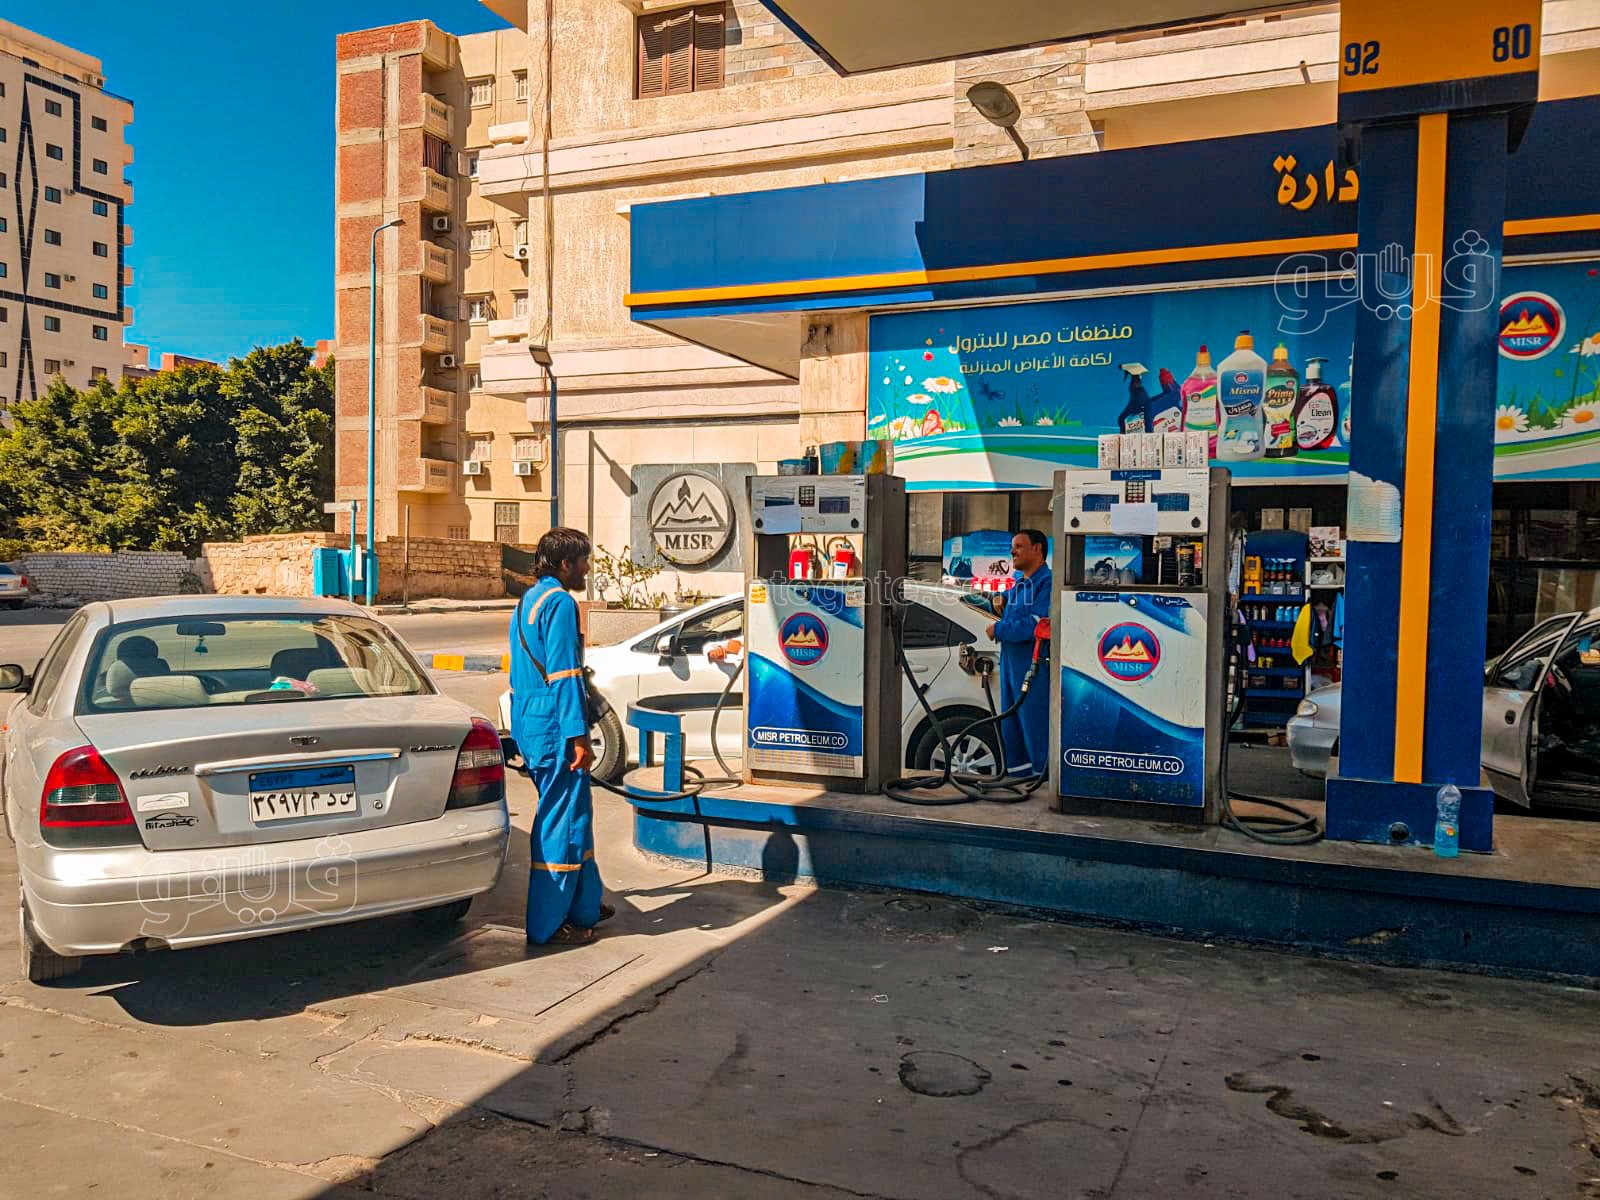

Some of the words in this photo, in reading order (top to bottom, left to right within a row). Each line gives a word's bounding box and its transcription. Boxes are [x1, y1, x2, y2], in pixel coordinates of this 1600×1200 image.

[1492, 23, 1532, 62] 80
[1344, 41, 1380, 76] 92
[1012, 332, 1051, 350] مصر
[1057, 325, 1133, 343] منظفات
[1510, 336, 1542, 347] MISR
[948, 331, 1008, 354] للبترول
[959, 359, 1011, 375] المنزلية
[1014, 354, 1065, 373] الأغراض
[1069, 352, 1112, 367] لكافة
[1231, 386, 1259, 395] Misrol
[1268, 389, 1294, 398] Prime
[665, 534, 714, 550] MISR
[791, 648, 816, 657] MISR
[1113, 662, 1144, 671] MISR
[757, 731, 778, 742] MISR
[1071, 753, 1096, 765] MISR
[259, 774, 294, 787] EGYPT
[253, 792, 302, 816] ٣٢٩٧
